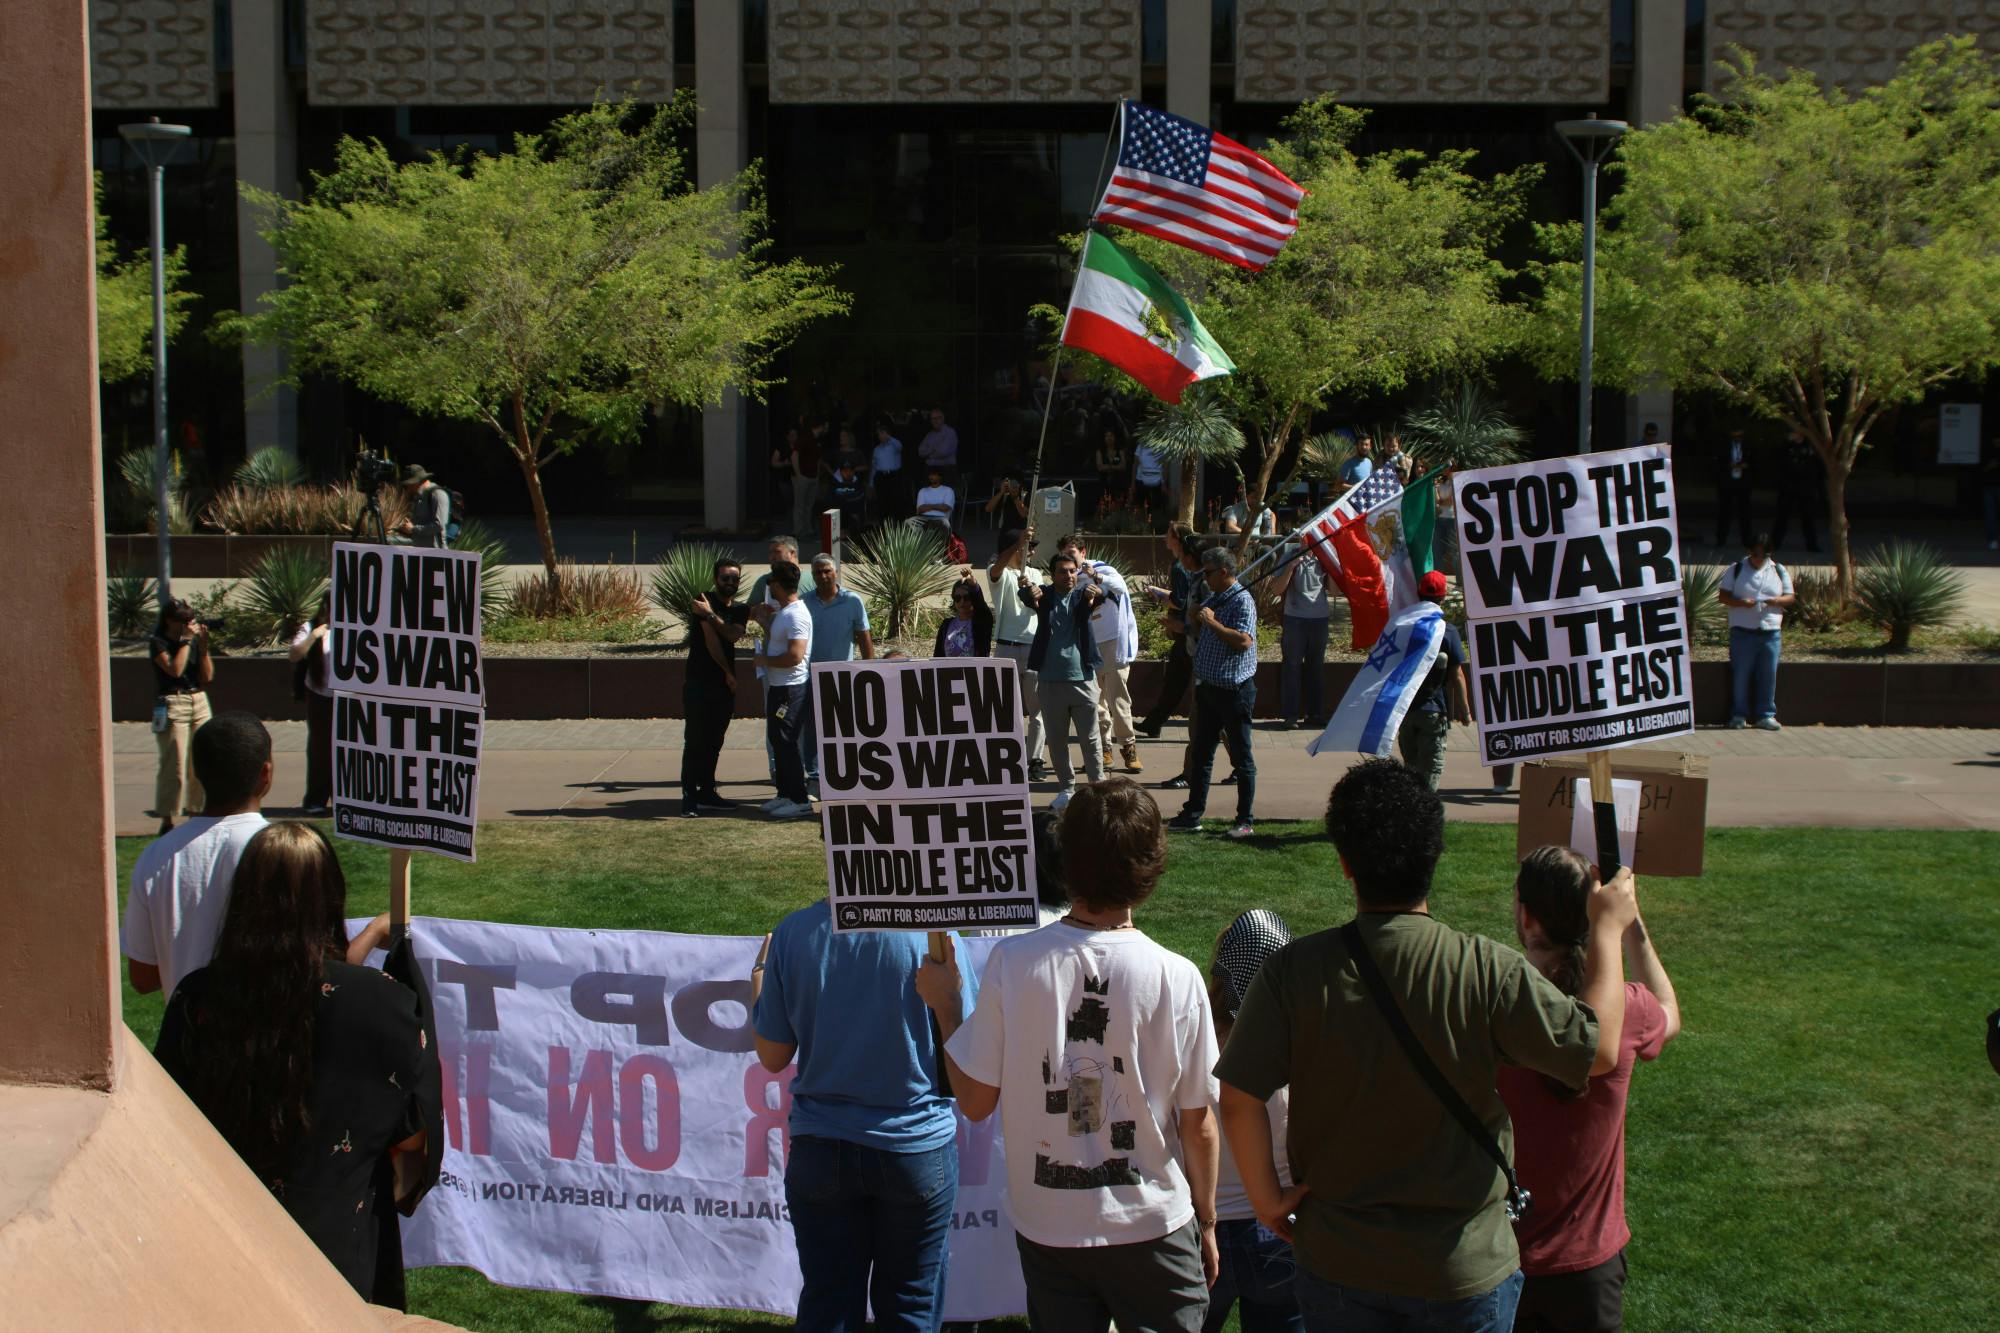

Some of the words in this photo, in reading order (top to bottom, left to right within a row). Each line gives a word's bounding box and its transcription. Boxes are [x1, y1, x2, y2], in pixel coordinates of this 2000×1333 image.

[1461, 472, 1579, 545] STOP
[1588, 458, 1670, 528] THE
[335, 550, 382, 626] NO
[390, 553, 477, 635] NEW
[1466, 526, 1677, 608] WAR
[333, 627, 379, 684] US
[383, 633, 480, 694] WAR
[1475, 617, 1549, 668] IN
[1553, 596, 1682, 657] THE
[818, 670, 888, 738] NO
[901, 667, 1014, 736] NEW
[1480, 659, 1608, 726] MIDDLE
[1613, 646, 1684, 708] EAST
[337, 697, 377, 746] IN
[381, 702, 479, 758] THE
[1514, 731, 1546, 750] PARTY
[1550, 729, 1570, 744] FOR
[1573, 722, 1625, 743] SOCIALISM
[1627, 719, 1635, 734] &
[1637, 709, 1689, 732] LIBERATION
[337, 746, 418, 808] MIDDLE
[426, 757, 476, 817] EAST
[823, 741, 894, 791] US
[897, 738, 1025, 788] WAR
[353, 814, 373, 832] PARTY
[374, 817, 386, 835] FOR
[387, 820, 432, 840] SOCIALISM
[440, 826, 472, 849] LIBERATION
[829, 804, 895, 845] IN
[899, 800, 1027, 844] THE
[833, 849, 948, 896] MIDDLE
[954, 845, 1028, 894] EAST
[863, 908, 892, 922] PARTY
[894, 907, 912, 922] FOR
[915, 906, 966, 922] SOCIALISM
[969, 907, 976, 920] &
[979, 905, 1033, 919] LIBERATION
